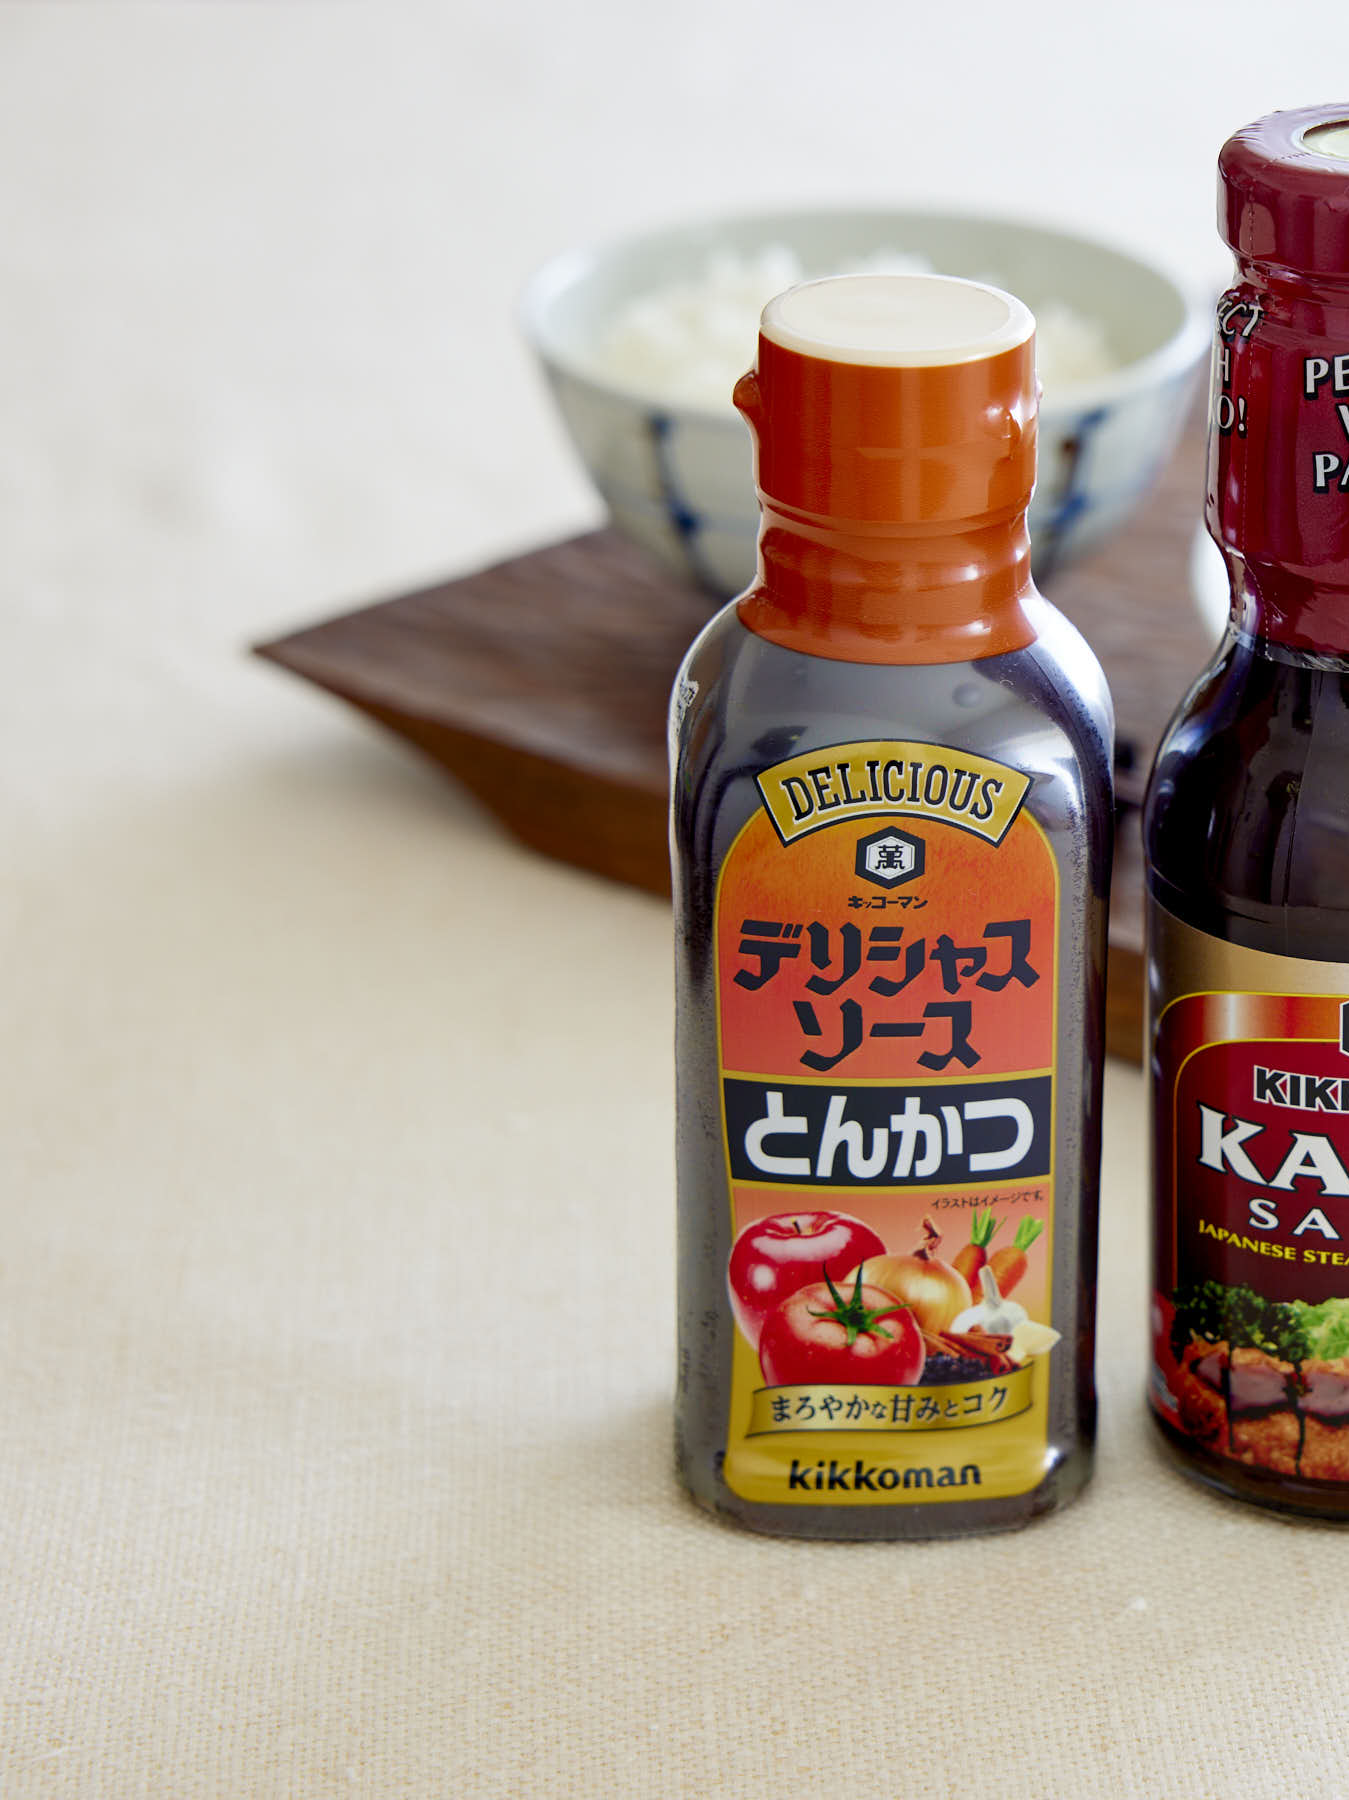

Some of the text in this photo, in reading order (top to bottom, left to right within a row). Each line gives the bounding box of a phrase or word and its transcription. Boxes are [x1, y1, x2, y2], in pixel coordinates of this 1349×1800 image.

[782, 759, 1003, 822] DELICIOUS
[848, 895, 928, 909] キッコーマン
[733, 919, 1040, 997] デリシャス
[792, 998, 982, 1072] ソース
[744, 1090, 1035, 1178] とんかつ
[1199, 1220, 1297, 1261] JAPANESE
[771, 1386, 1008, 1423] まろやかな甘みとコク
[789, 1459, 982, 1490] kikkoman
